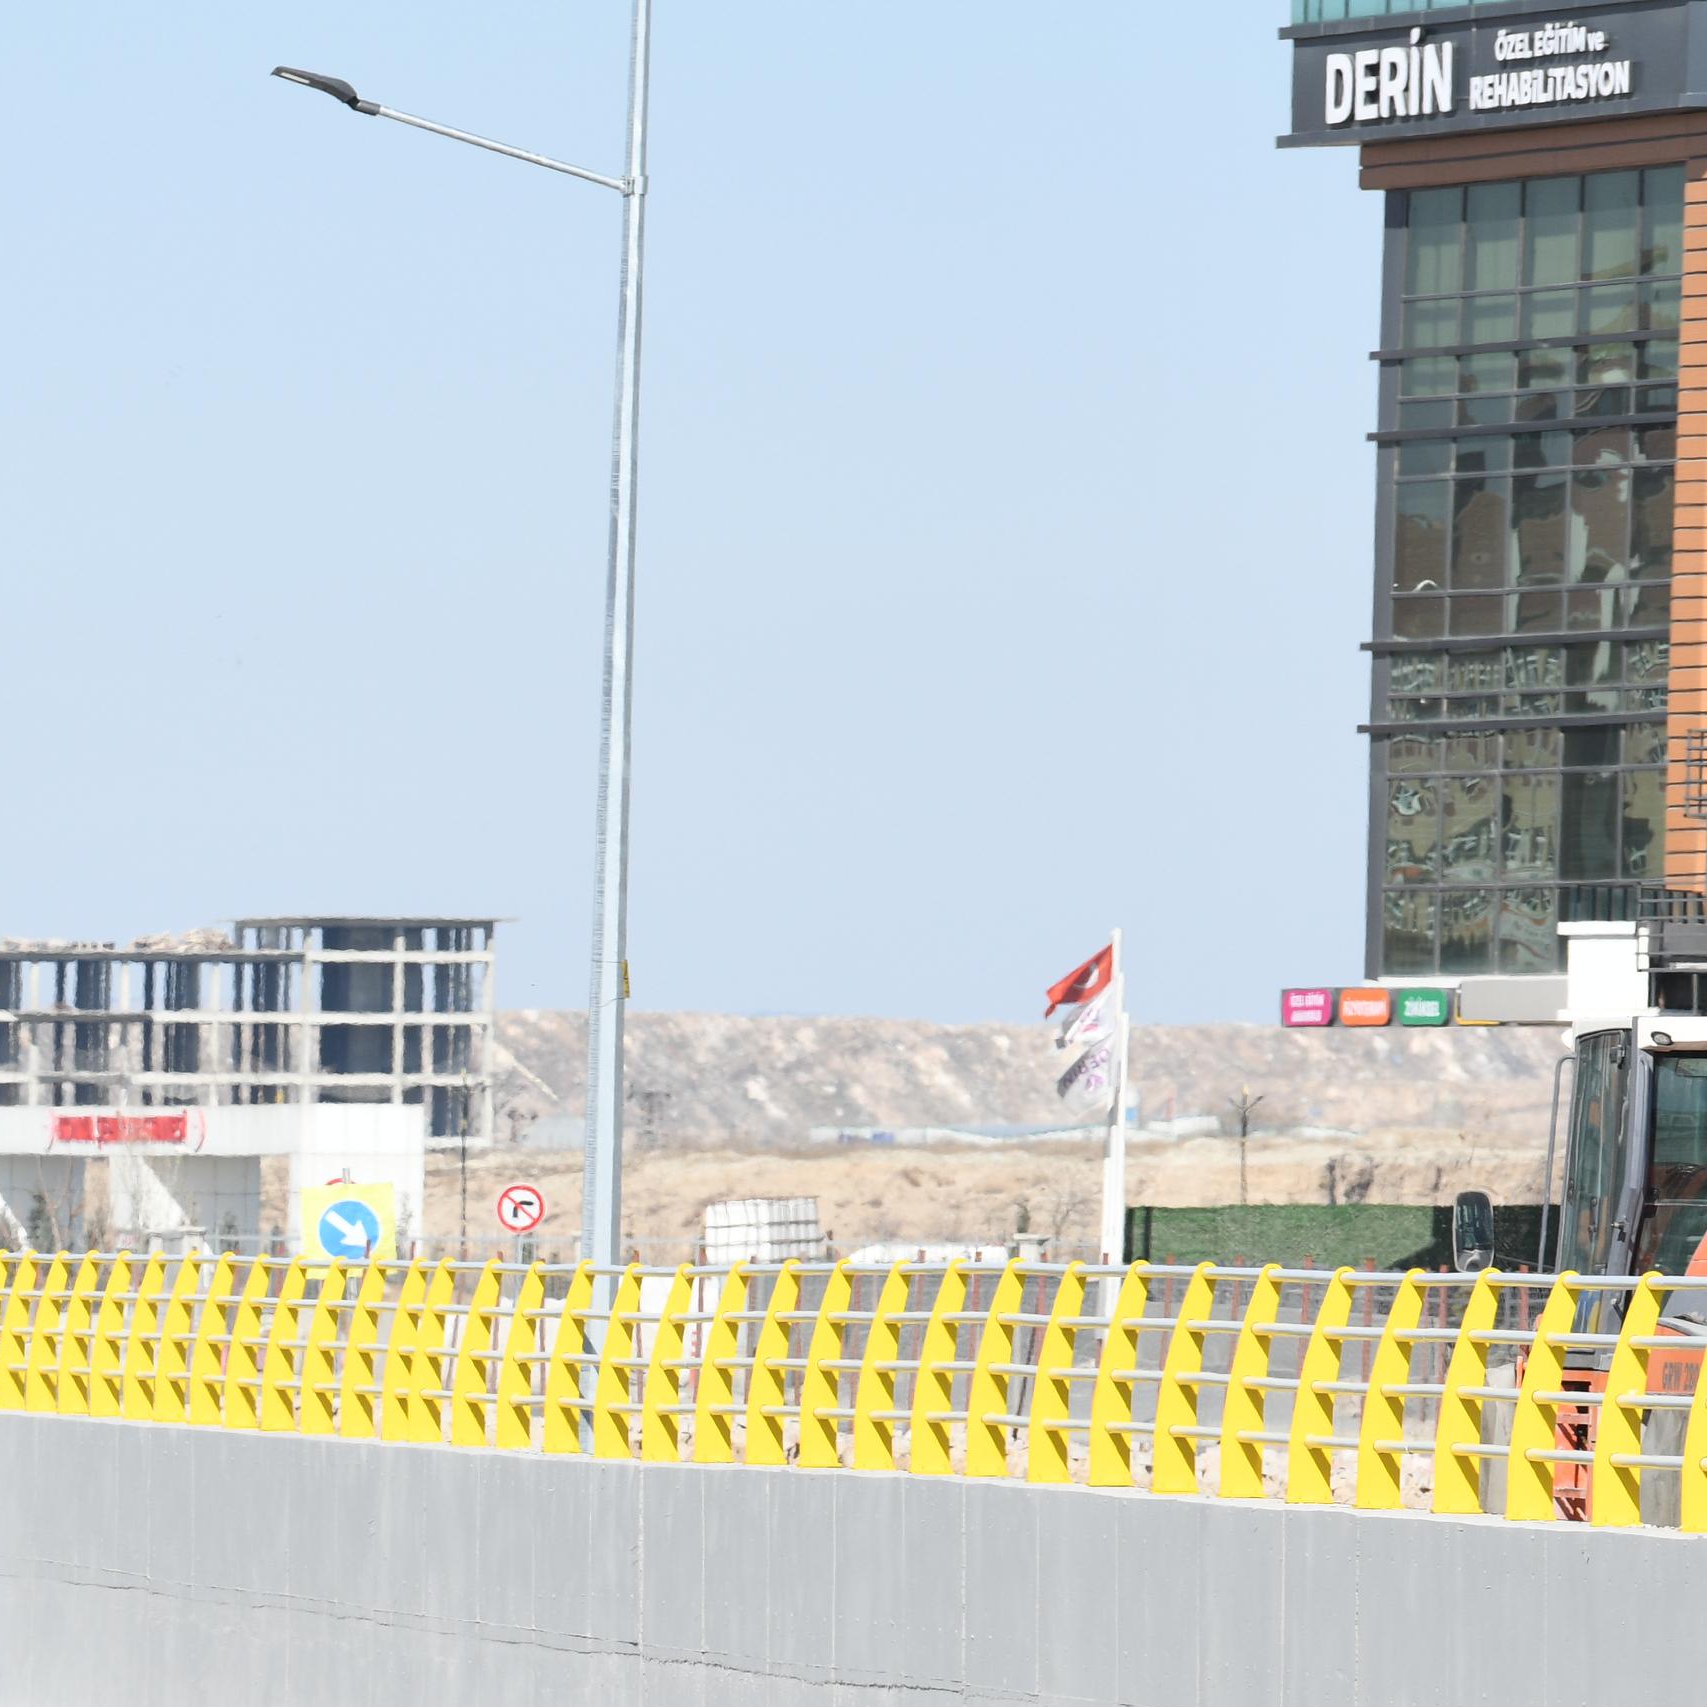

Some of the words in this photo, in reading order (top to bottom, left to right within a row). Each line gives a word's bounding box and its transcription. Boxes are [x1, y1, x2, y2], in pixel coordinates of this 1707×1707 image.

[1495, 29, 1532, 61] ÖZEL
[1533, 21, 1587, 57] EĞİTİM
[1587, 30, 1606, 51] ve
[1325, 27, 1453, 124] DERİN
